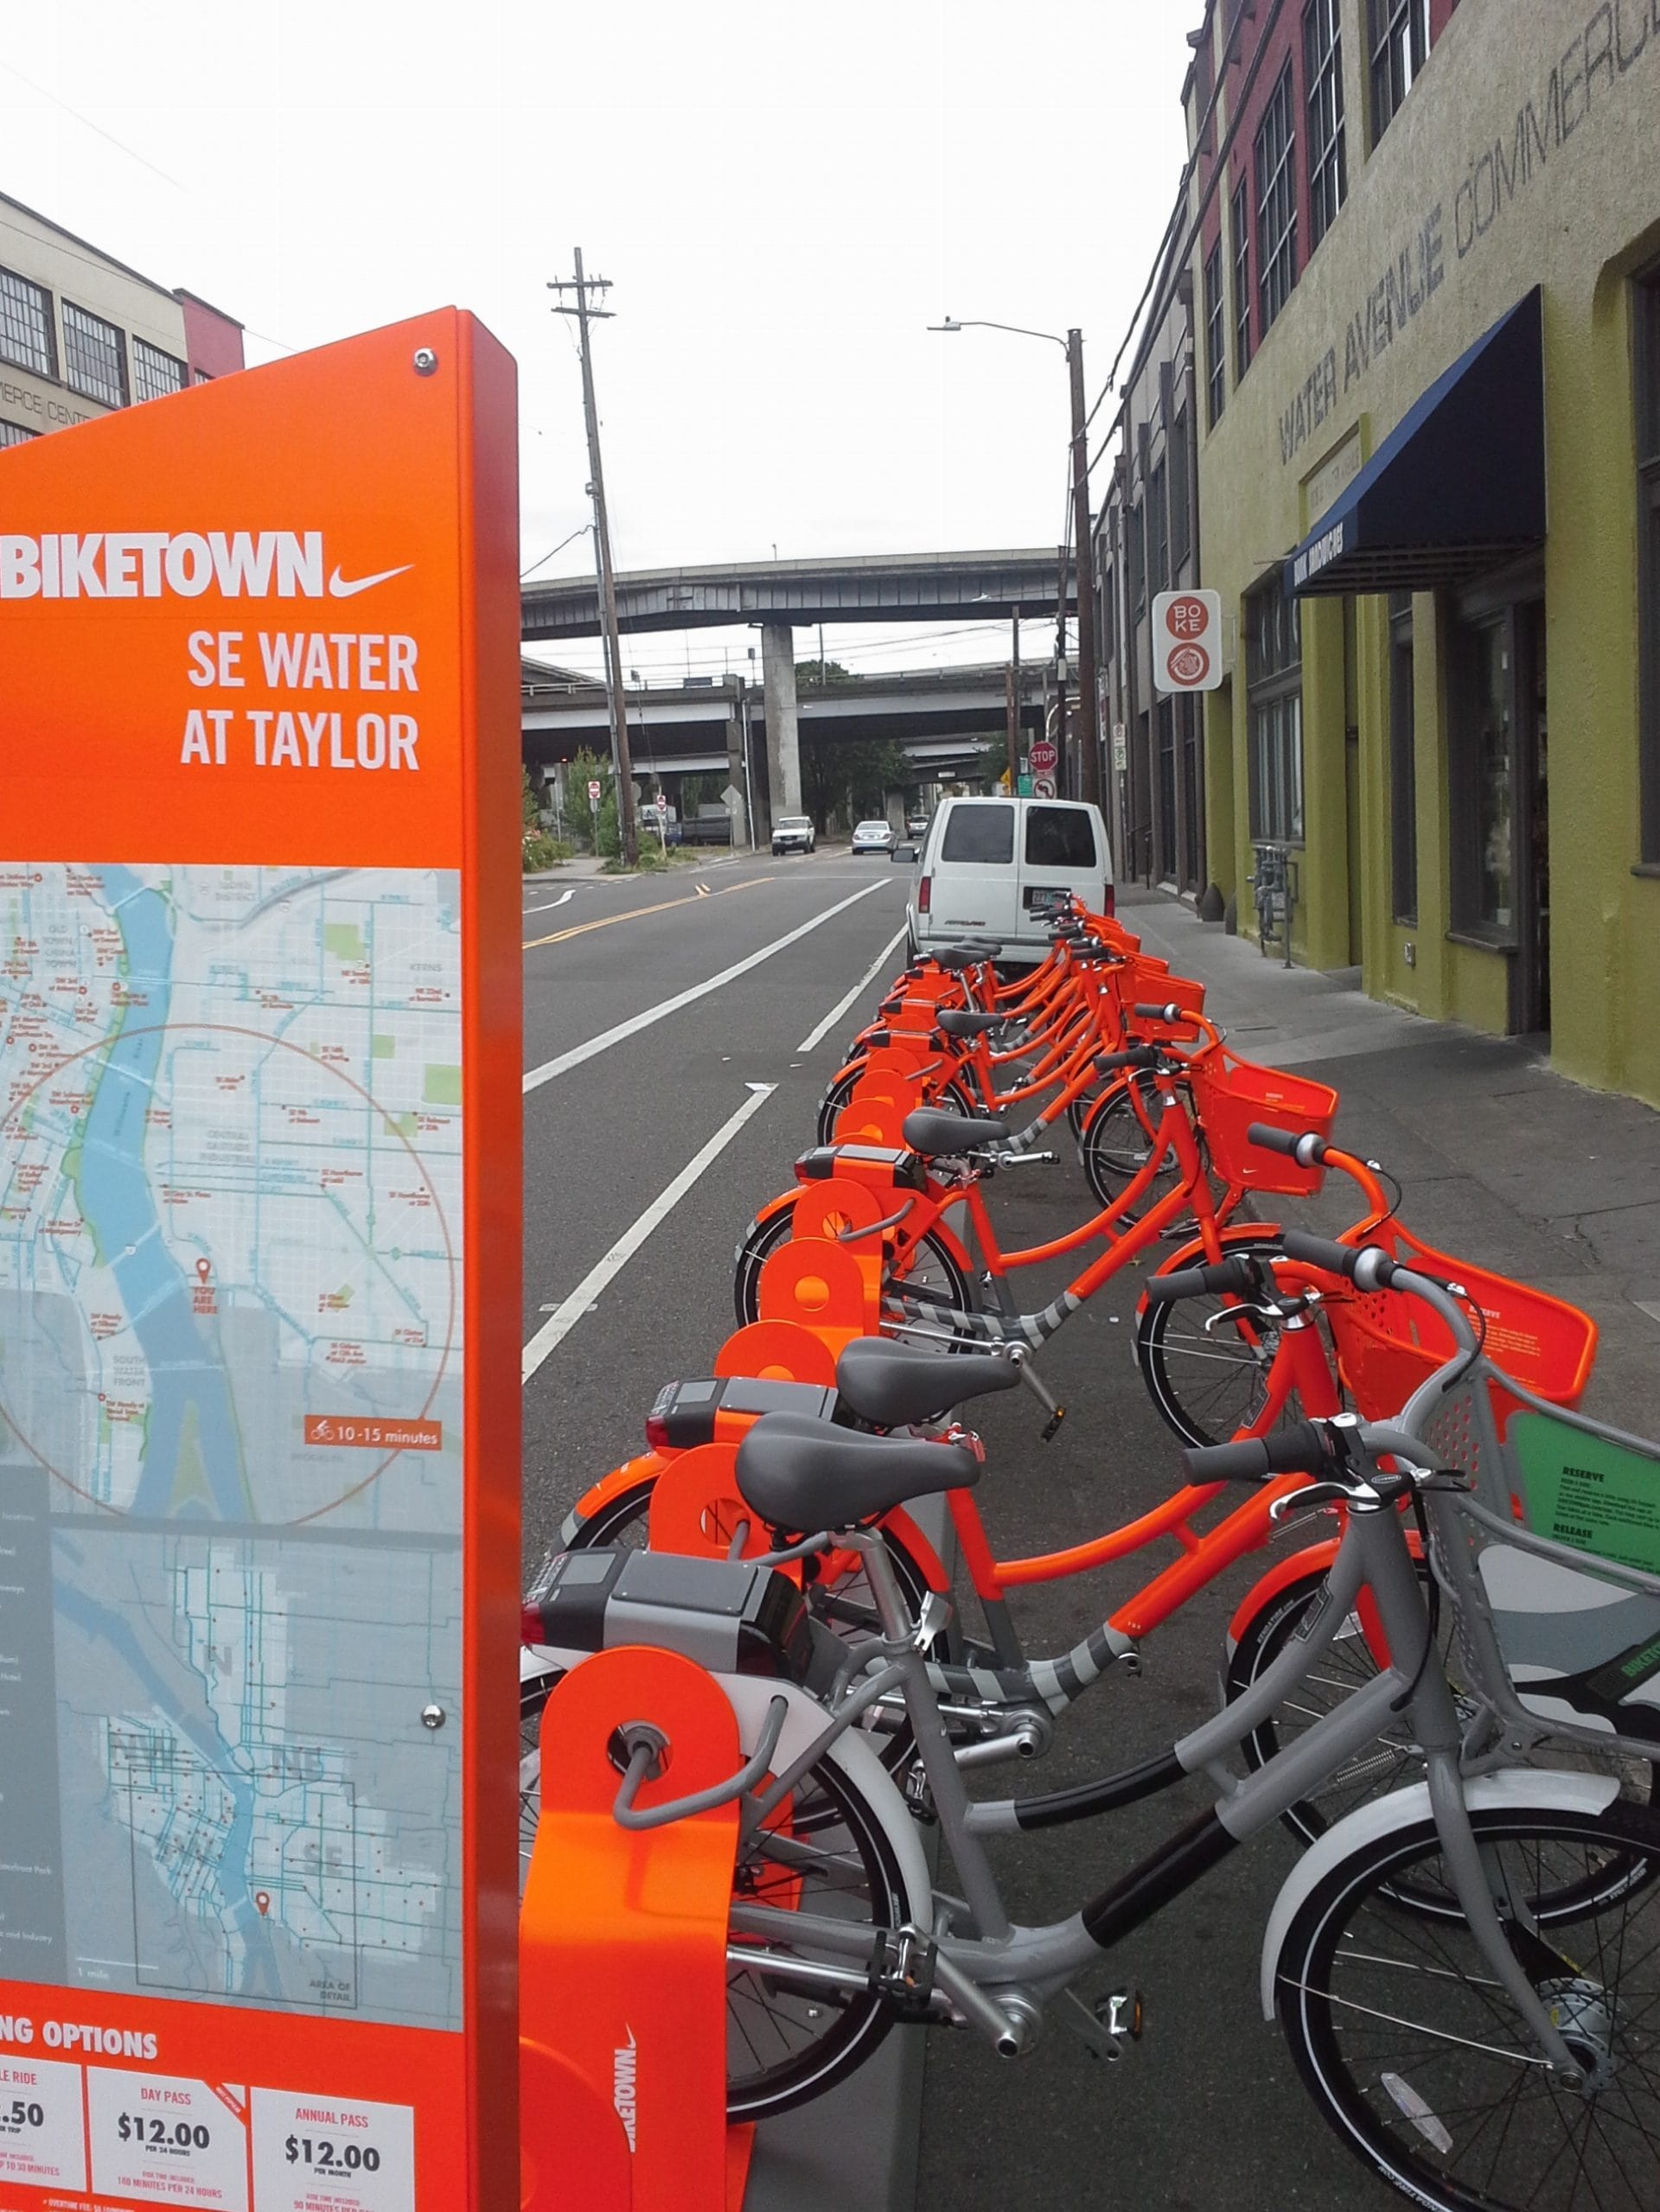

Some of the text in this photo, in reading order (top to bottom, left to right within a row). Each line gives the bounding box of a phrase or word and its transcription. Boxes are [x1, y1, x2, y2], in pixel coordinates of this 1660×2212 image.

[1280, 346, 1337, 467] WATER
[1344, 202, 1444, 394] AVENUE
[48, 401, 92, 426] CENT
[0, 531, 323, 598] BIKETOWN
[1173, 604, 1201, 619] BO
[1176, 618, 1201, 632] KE
[187, 631, 419, 692] SE WATER
[180, 709, 420, 770] AT TAYLOR
[1031, 750, 1056, 762] STOP
[385, 1428, 437, 1445] minutes
[1562, 1466, 1606, 1482] RESERVE
[1553, 1522, 1593, 1539] RELEASE
[42, 2021, 158, 2061] OPTIONS
[13, 2071, 37, 2085] RIDE
[141, 2088, 192, 2107] DAY PASS
[296, 2107, 369, 2129] ANNUAL PASS
[118, 2112, 210, 2150] $12.00
[285, 2133, 380, 2172] $12.00
[28, 2164, 60, 2177] MINUTES
[133, 2179, 166, 2192] MINUTES
[168, 2183, 183, 2194] PER
[185, 2187, 195, 2196] 24
[196, 2188, 223, 2199] HOURS
